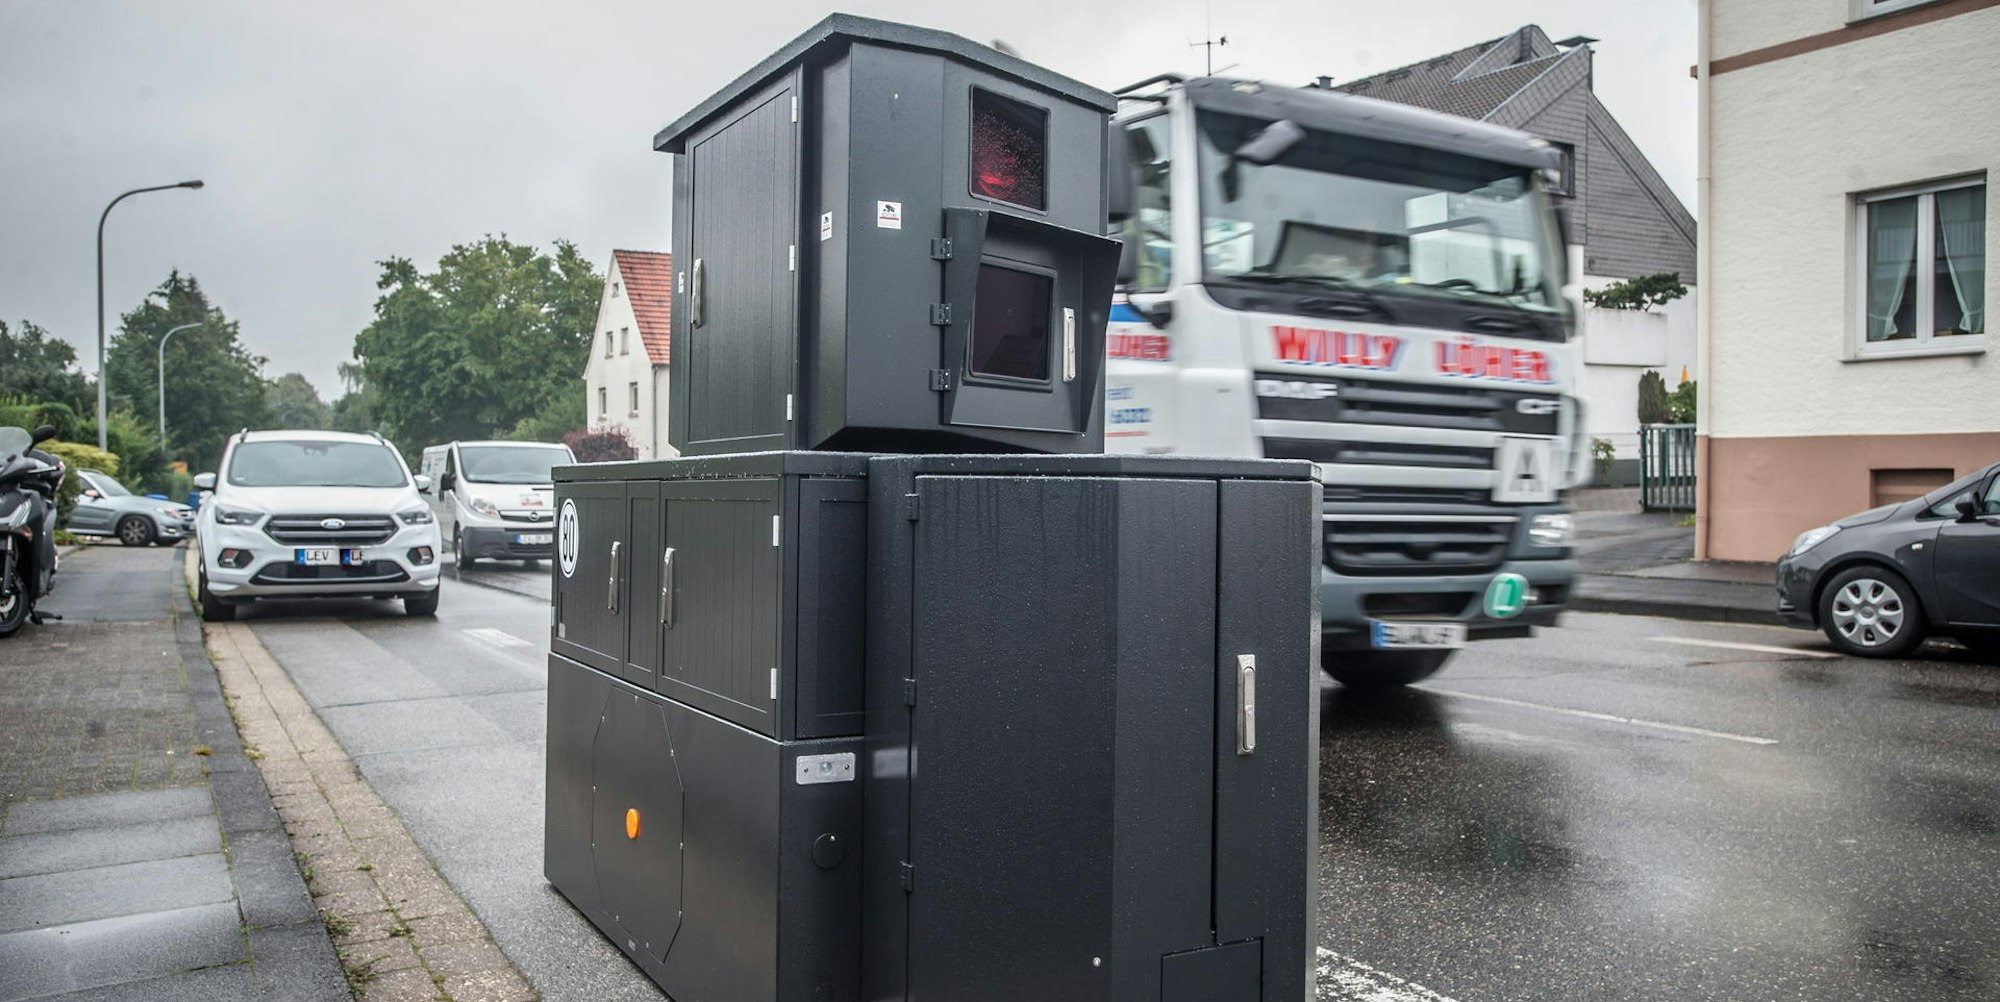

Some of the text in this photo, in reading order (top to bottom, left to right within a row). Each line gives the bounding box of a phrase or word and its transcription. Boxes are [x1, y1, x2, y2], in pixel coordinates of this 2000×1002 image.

[1269, 325, 1556, 385] WILLY LÖHER
[306, 551, 330, 561] LEV
[562, 513, 575, 563] 80
